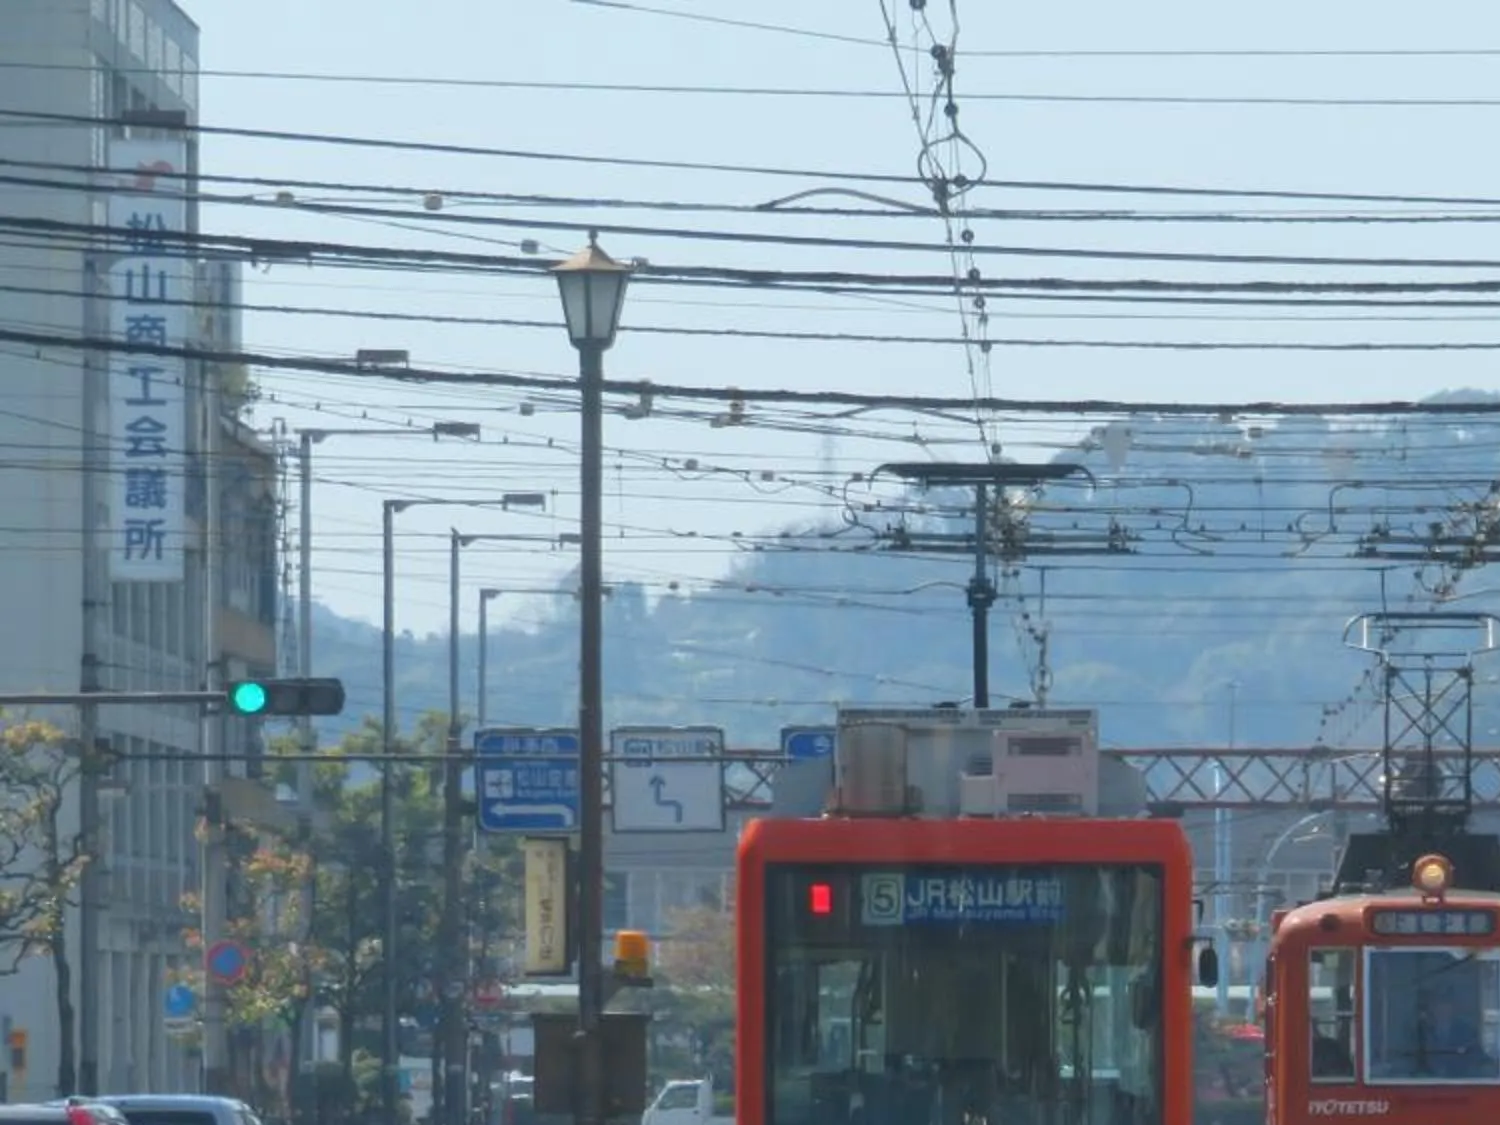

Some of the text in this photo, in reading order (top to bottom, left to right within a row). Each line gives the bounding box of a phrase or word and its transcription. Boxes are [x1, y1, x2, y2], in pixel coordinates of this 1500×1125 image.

[124, 212, 167, 561] 松山商工会議所
[1308, 1100, 1390, 1116] IYOTETSU
